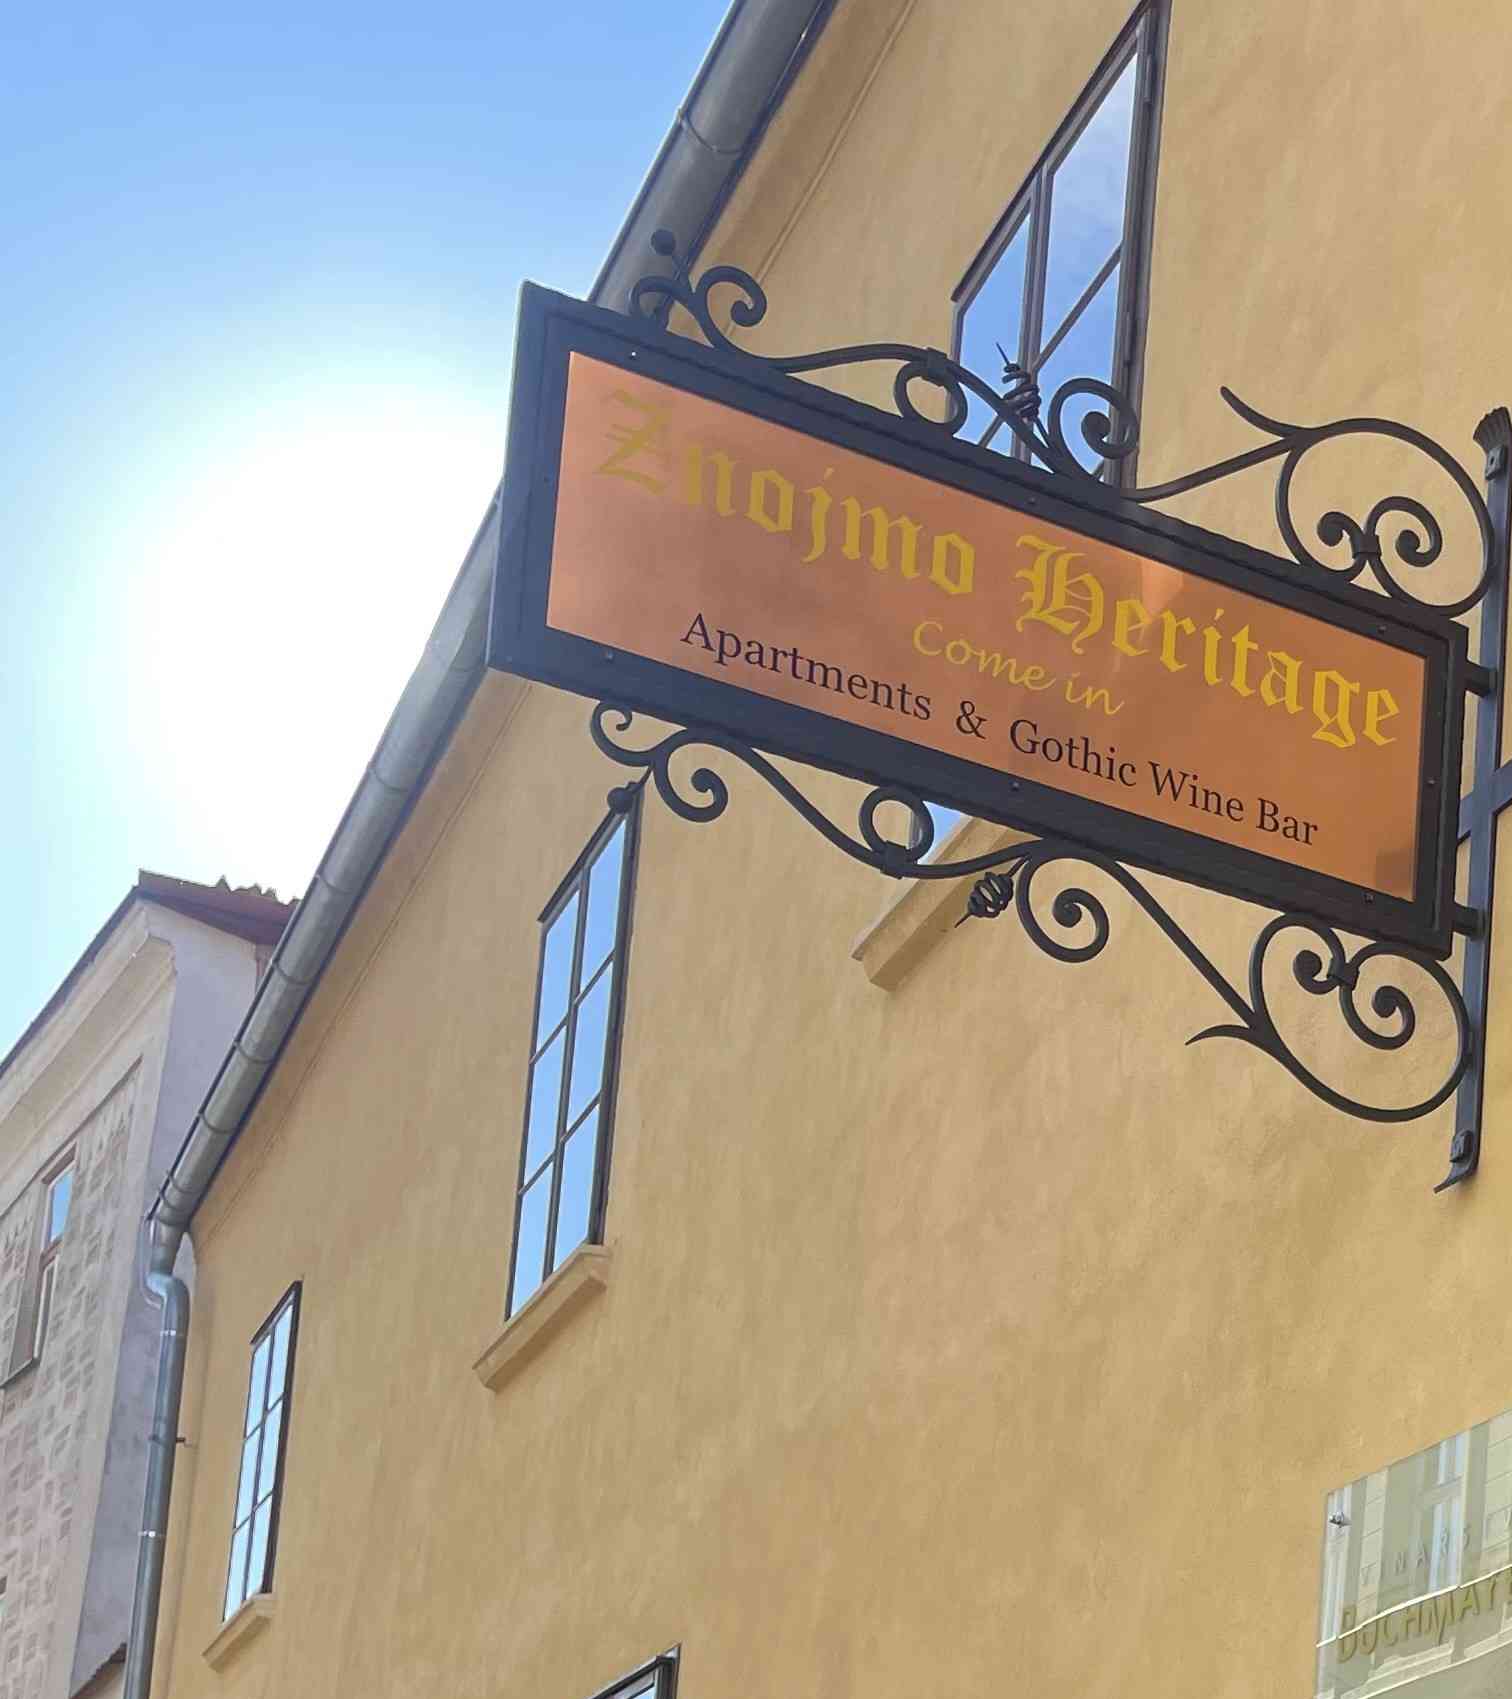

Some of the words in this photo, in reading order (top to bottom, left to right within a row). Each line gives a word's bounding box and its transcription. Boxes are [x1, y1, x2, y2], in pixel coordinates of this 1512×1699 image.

[593, 388, 975, 595] Znojmo
[1011, 534, 1401, 749] Heritage
[912, 620, 1057, 691] Come
[1063, 672, 1126, 717] in
[679, 611, 932, 722] Apartments
[955, 700, 988, 741] &
[1009, 718, 1138, 788] Gothic
[1148, 760, 1246, 823] Wine
[1256, 797, 1319, 847] Bar
